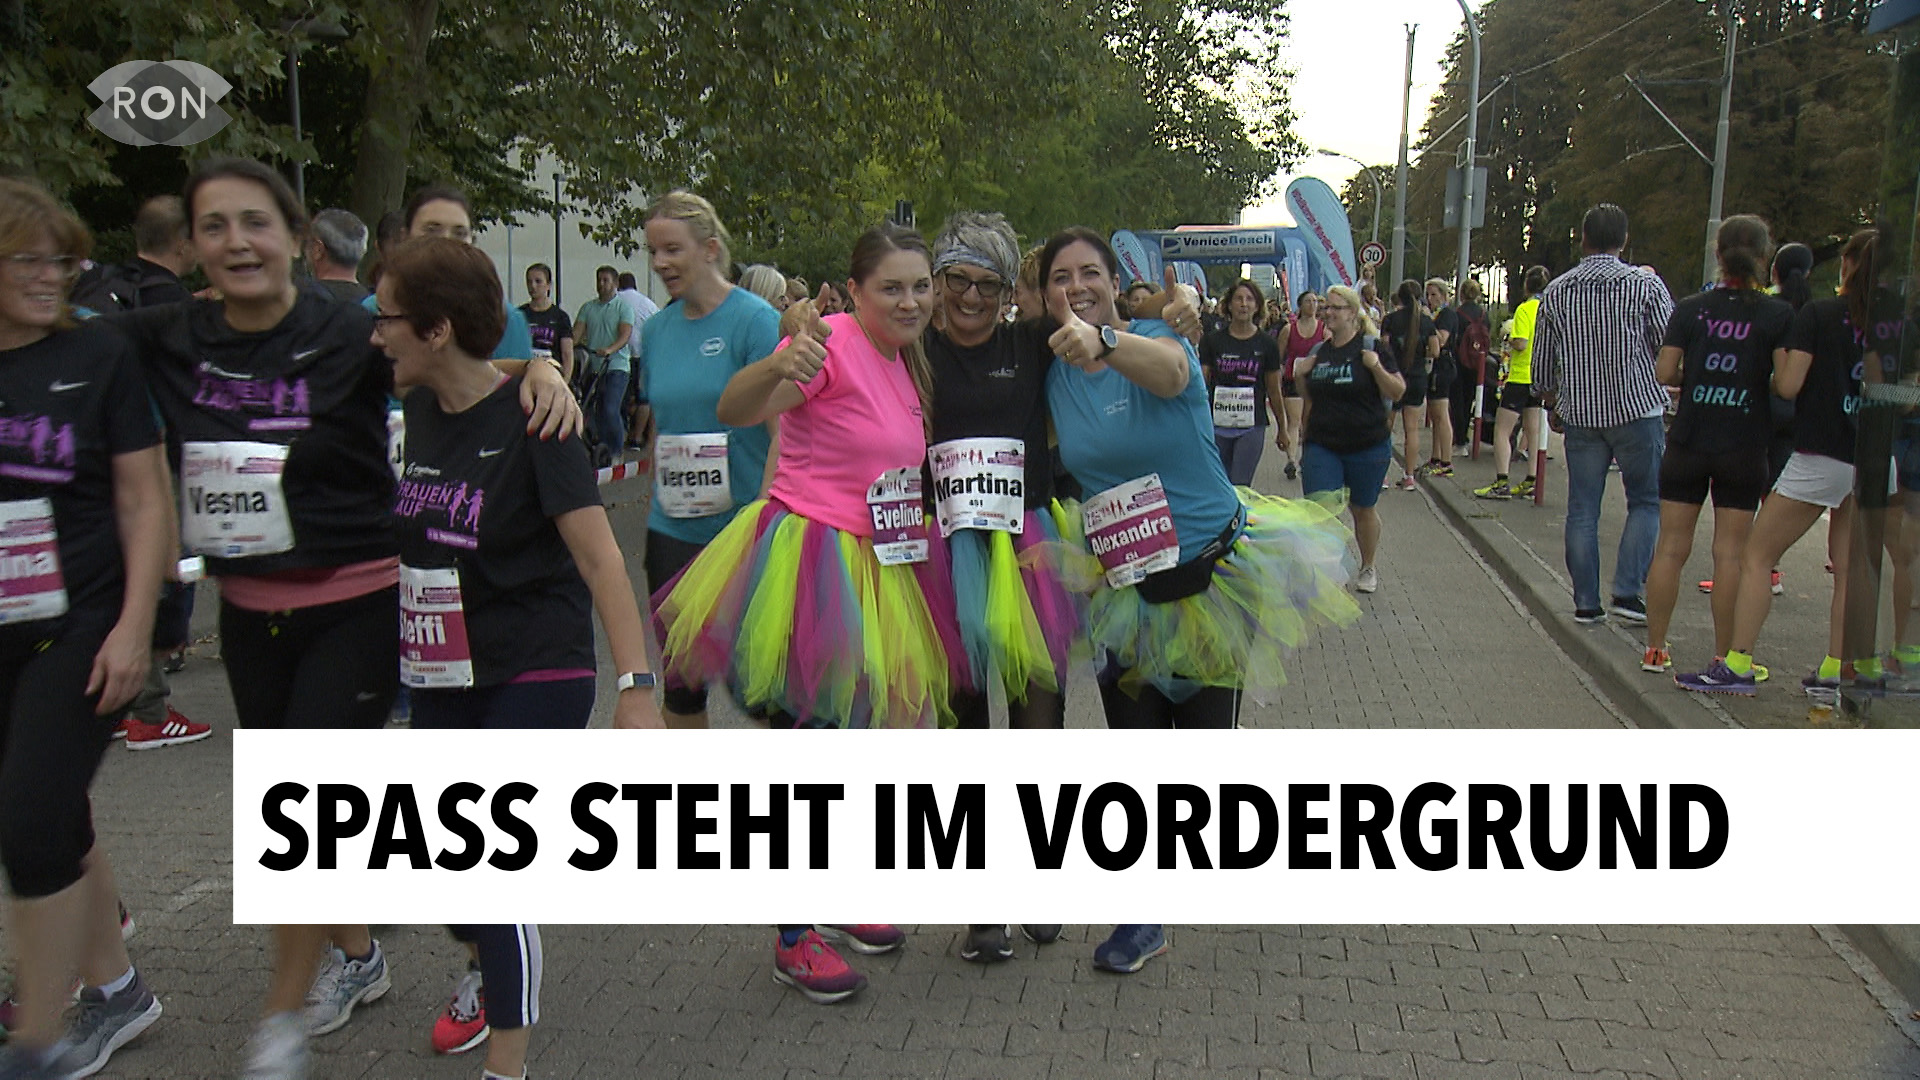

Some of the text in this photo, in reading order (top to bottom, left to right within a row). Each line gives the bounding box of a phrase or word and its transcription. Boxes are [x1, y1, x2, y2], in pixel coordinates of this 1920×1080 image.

[1183, 234, 1272, 246] VeniceBeach
[1365, 249, 1380, 262] 30
[1706, 319, 1751, 340] YOU
[1214, 402, 1253, 412] Christina
[1692, 384, 1748, 407] GIRL!
[935, 472, 1022, 504] Martina
[188, 486, 269, 514] Vesna
[871, 502, 923, 530] Eveline
[1091, 515, 1172, 556] Alexandra
